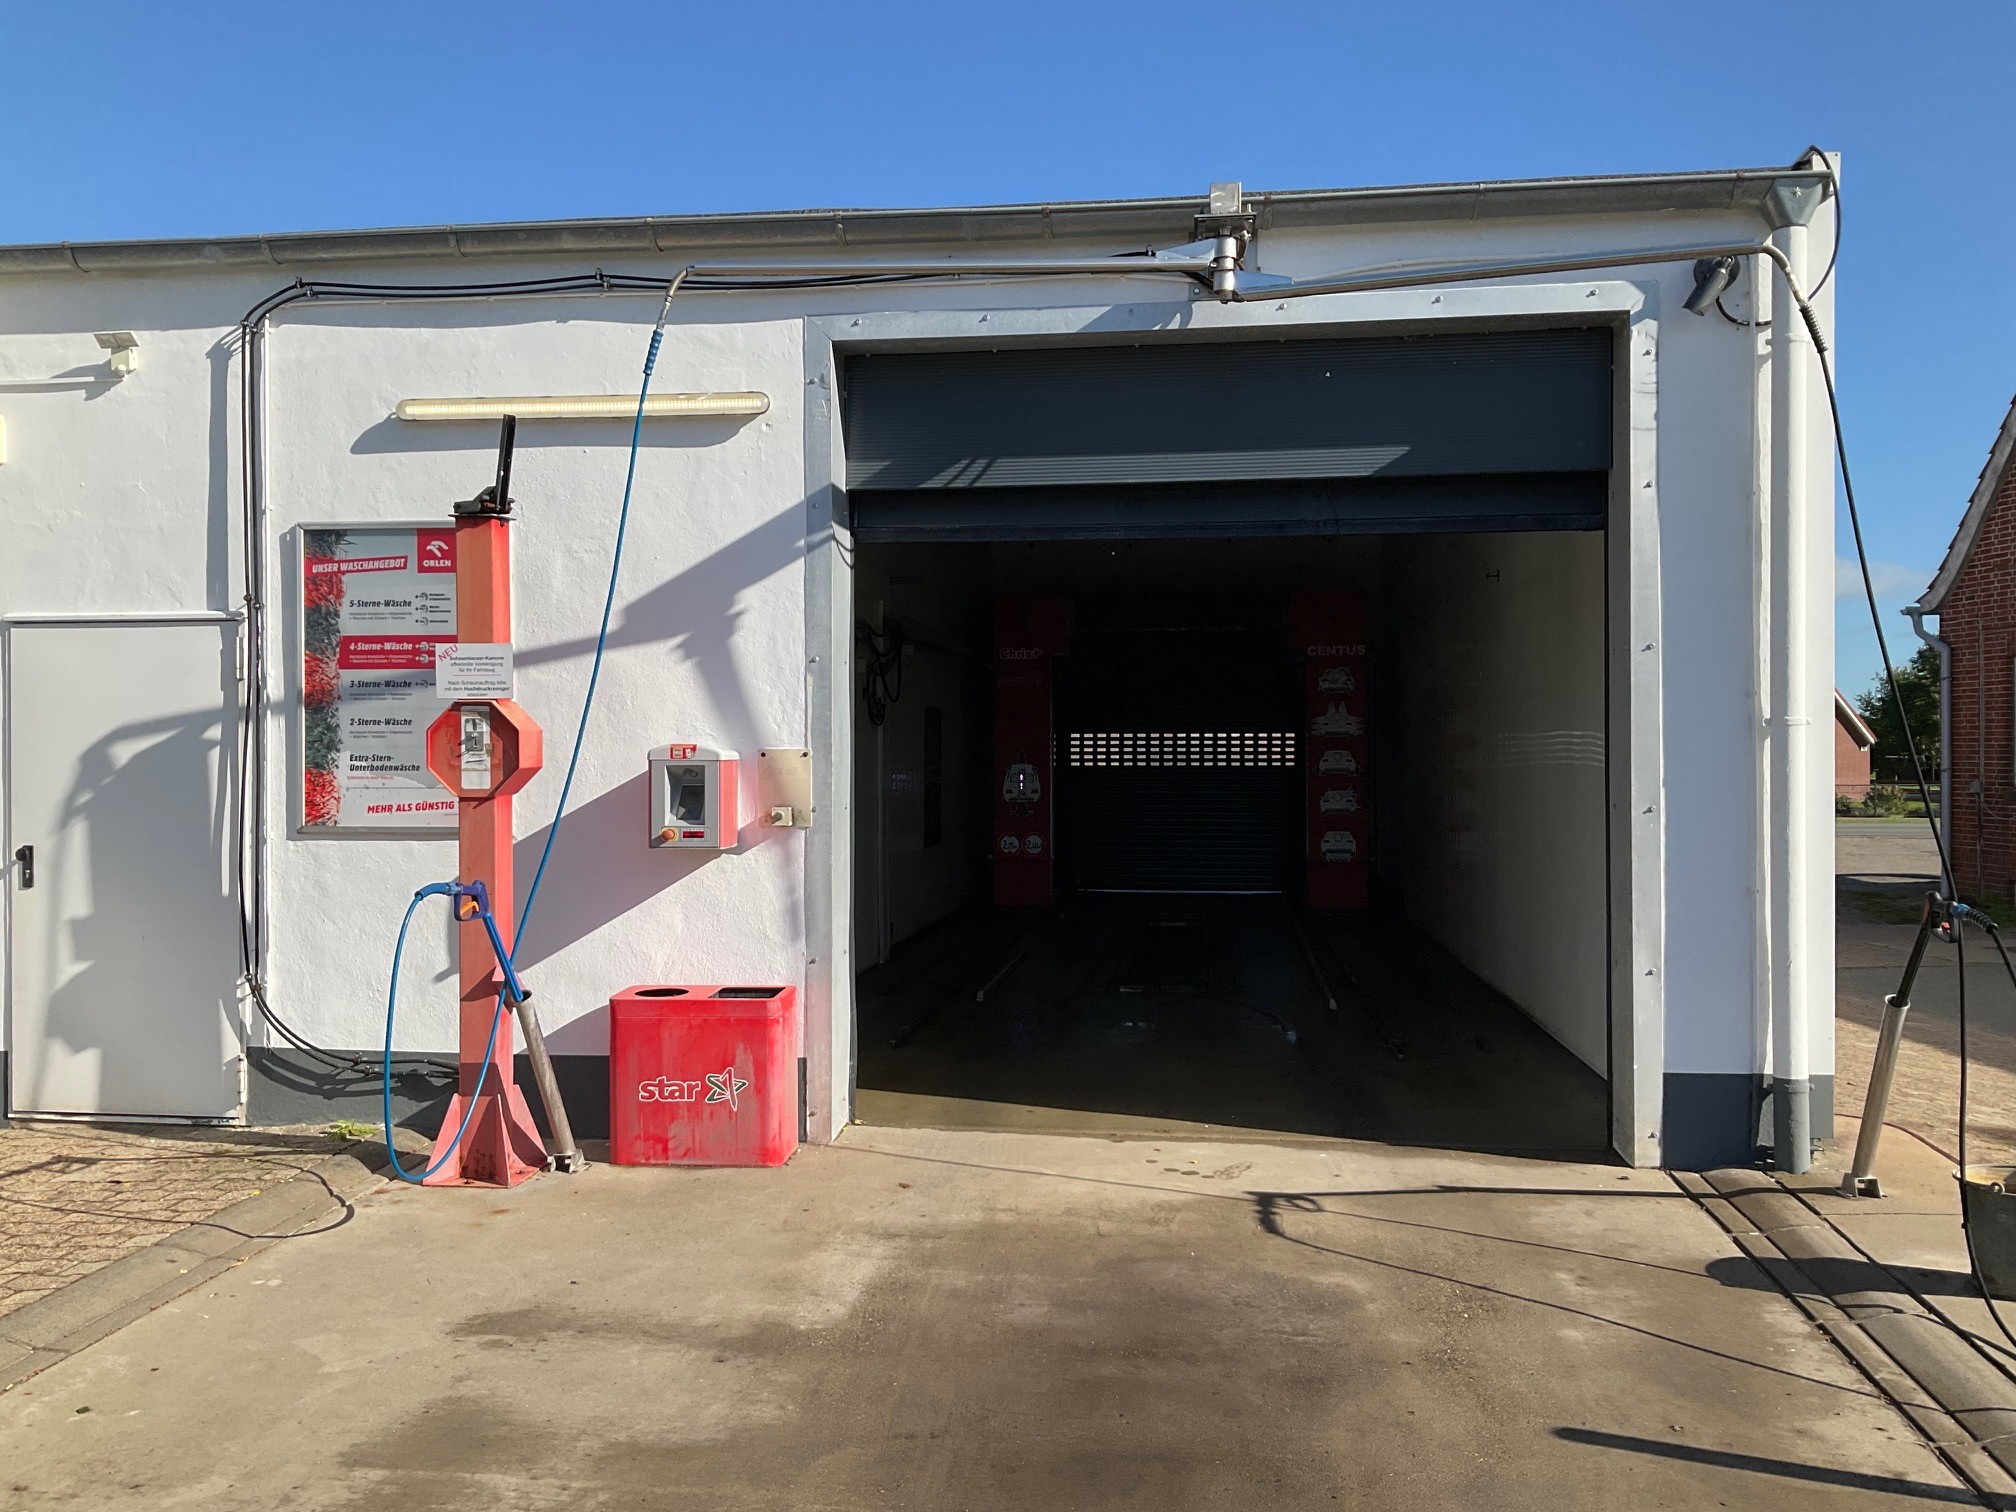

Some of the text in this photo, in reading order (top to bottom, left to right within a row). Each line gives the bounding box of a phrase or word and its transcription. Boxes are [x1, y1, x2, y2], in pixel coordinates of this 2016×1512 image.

[312, 558, 406, 573] UNSER WASCHANGEBOT
[349, 599, 412, 608] 5-Sterne-Wäsche
[349, 642, 413, 651] 4-Sterne-Wäsche
[1307, 645, 1366, 656] CENTUS
[438, 644, 458, 662] NEU
[999, 648, 1044, 659] Christ
[349, 680, 412, 689] 3-Sterne-Wäsche
[349, 718, 413, 726] 2-Sterne-Wäsche
[349, 754, 394, 762] Extra-Stern-
[349, 763, 421, 771] Unterbodenwäsche
[367, 801, 455, 814] MEHR ALS GÜNSTIG
[638, 1075, 702, 1102] star
